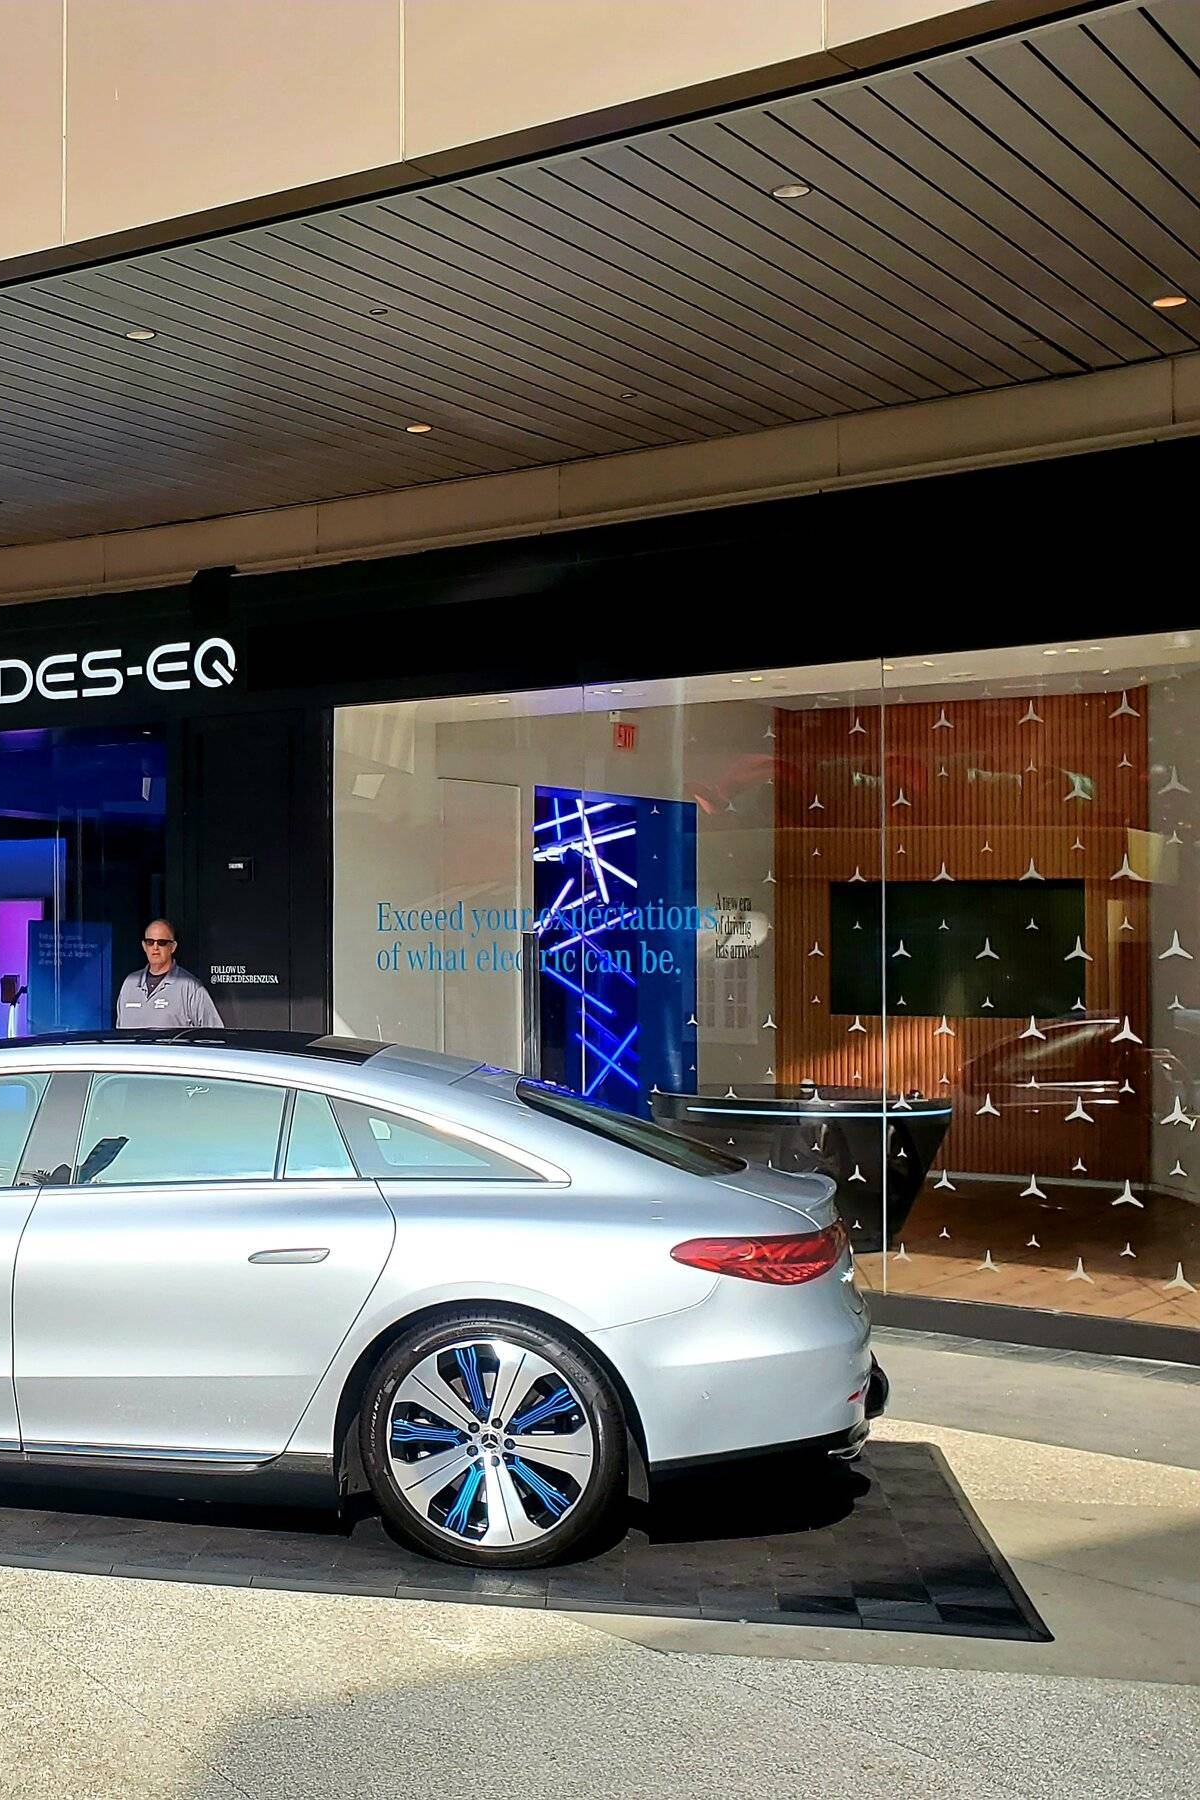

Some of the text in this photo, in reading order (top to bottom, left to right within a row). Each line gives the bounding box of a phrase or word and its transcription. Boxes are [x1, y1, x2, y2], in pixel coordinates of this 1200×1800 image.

[722, 897, 738, 911] new
[740, 897, 752, 911] era
[377, 898, 717, 938] Exceed your expectations
[725, 915, 752, 939] driving
[377, 941, 681, 974] of what elecric can be.
[715, 940, 728, 959] has
[210, 965, 246, 974] FOLLOW US
[210, 974, 279, 984] @MERCEDESBENZUSA
